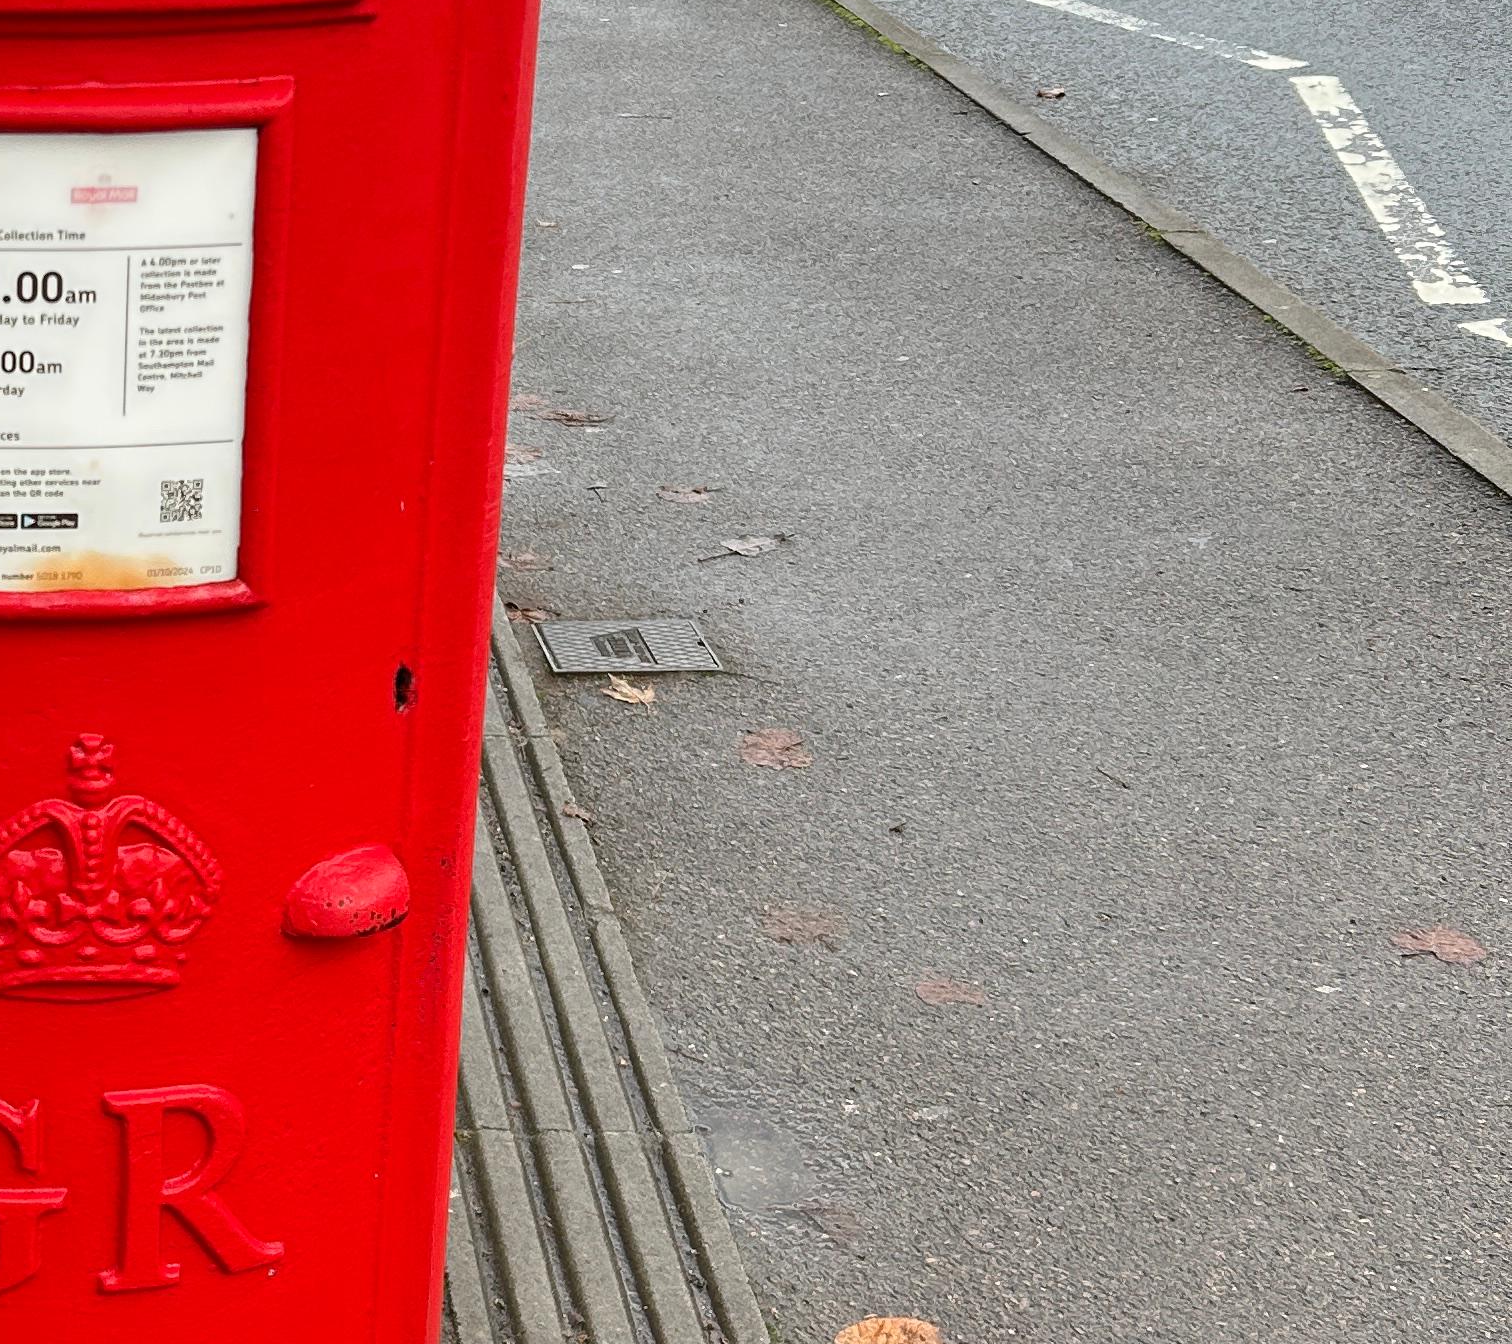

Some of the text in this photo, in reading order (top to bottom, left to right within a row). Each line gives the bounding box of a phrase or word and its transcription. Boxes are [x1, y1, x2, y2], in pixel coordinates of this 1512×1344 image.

[57, 229, 86, 241] Time
[22, 314, 35, 326] to
[40, 313, 80, 328] Friday
